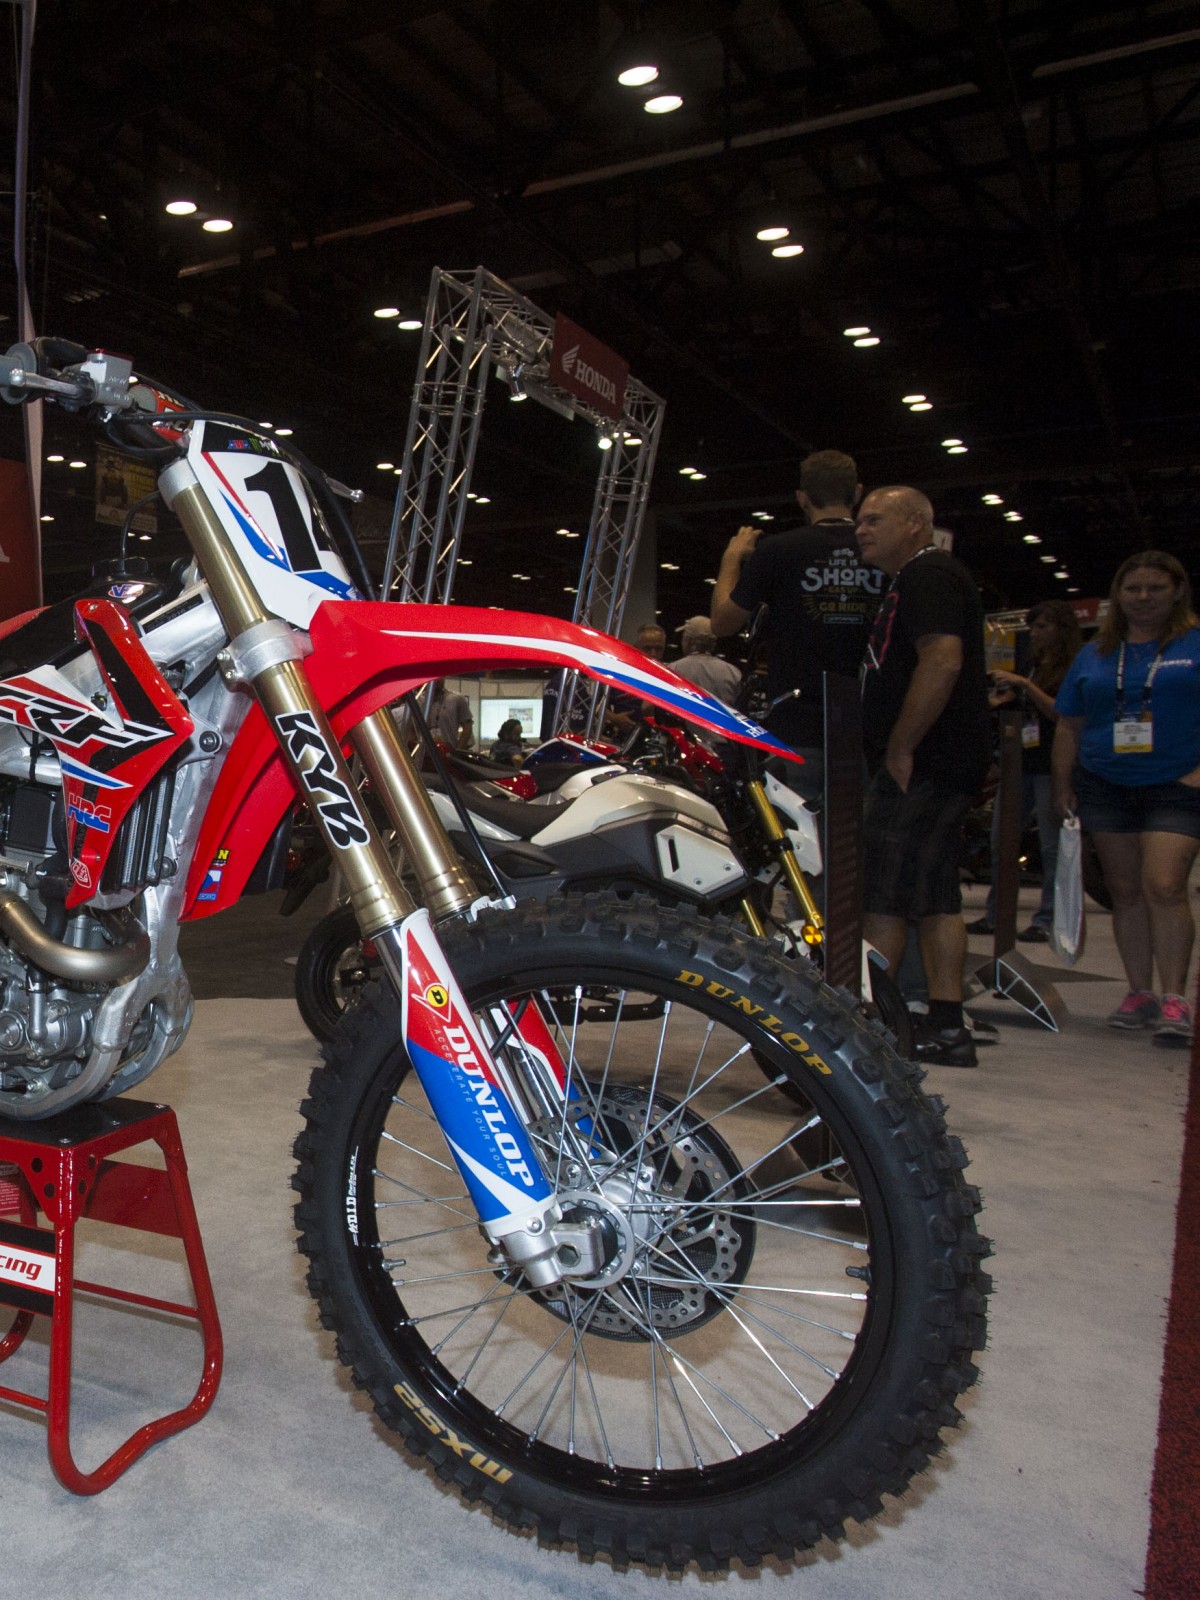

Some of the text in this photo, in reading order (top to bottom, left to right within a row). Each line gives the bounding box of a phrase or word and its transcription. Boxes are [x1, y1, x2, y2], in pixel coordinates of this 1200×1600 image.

[574, 359, 616, 405] HONDA
[243, 460, 323, 572] 1
[801, 566, 885, 594] SHORT
[67, 792, 113, 834] HRC
[274, 710, 371, 849] KYB
[675, 970, 833, 1075] DUNLOP
[434, 1029, 508, 1177] ACCELERATE YOUR SOUL
[443, 1025, 535, 1187] DUNLOP
[393, 1380, 514, 1484] MX52
